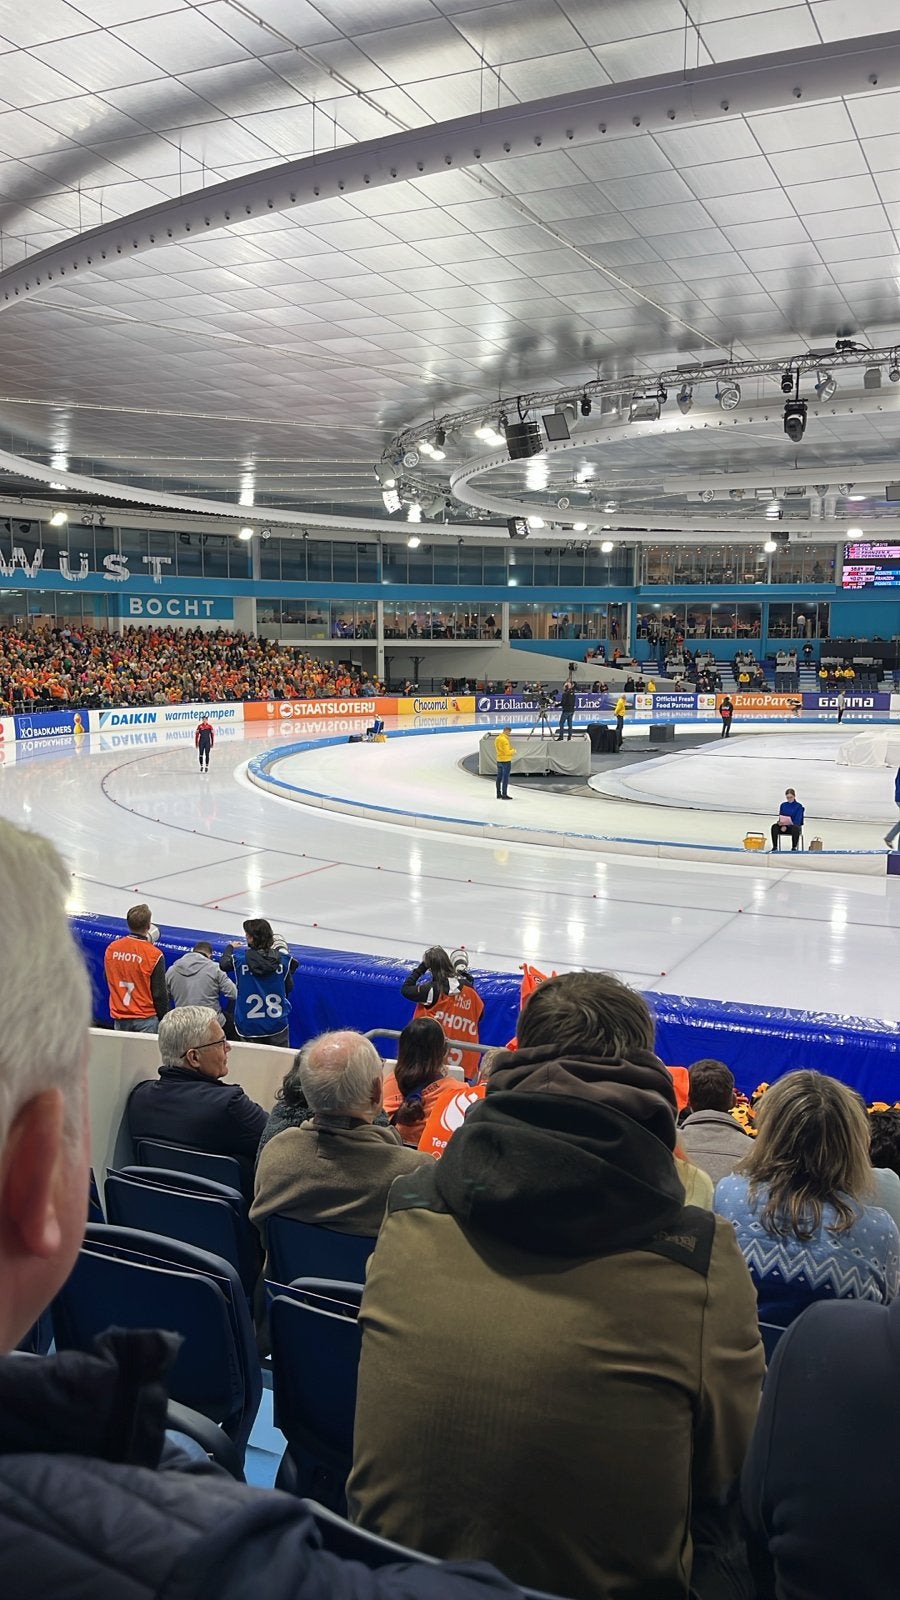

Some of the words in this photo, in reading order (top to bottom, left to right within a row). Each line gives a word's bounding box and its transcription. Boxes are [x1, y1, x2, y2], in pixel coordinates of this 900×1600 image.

[129, 597, 214, 616] BOCHT
[293, 702, 376, 715] STAATSLOTERIJ
[413, 698, 448, 713] Chocomel
[494, 698, 533, 710] Holland
[578, 697, 600, 709] Line
[111, 712, 157, 726] DAIKIN
[165, 709, 235, 722] warmtepompen
[33, 726, 72, 737] BADKAMERS
[112, 951, 143, 964] PHOTO
[118, 980, 135, 1006] 7
[245, 993, 283, 1019] 28
[432, 1136, 448, 1149] Tea
